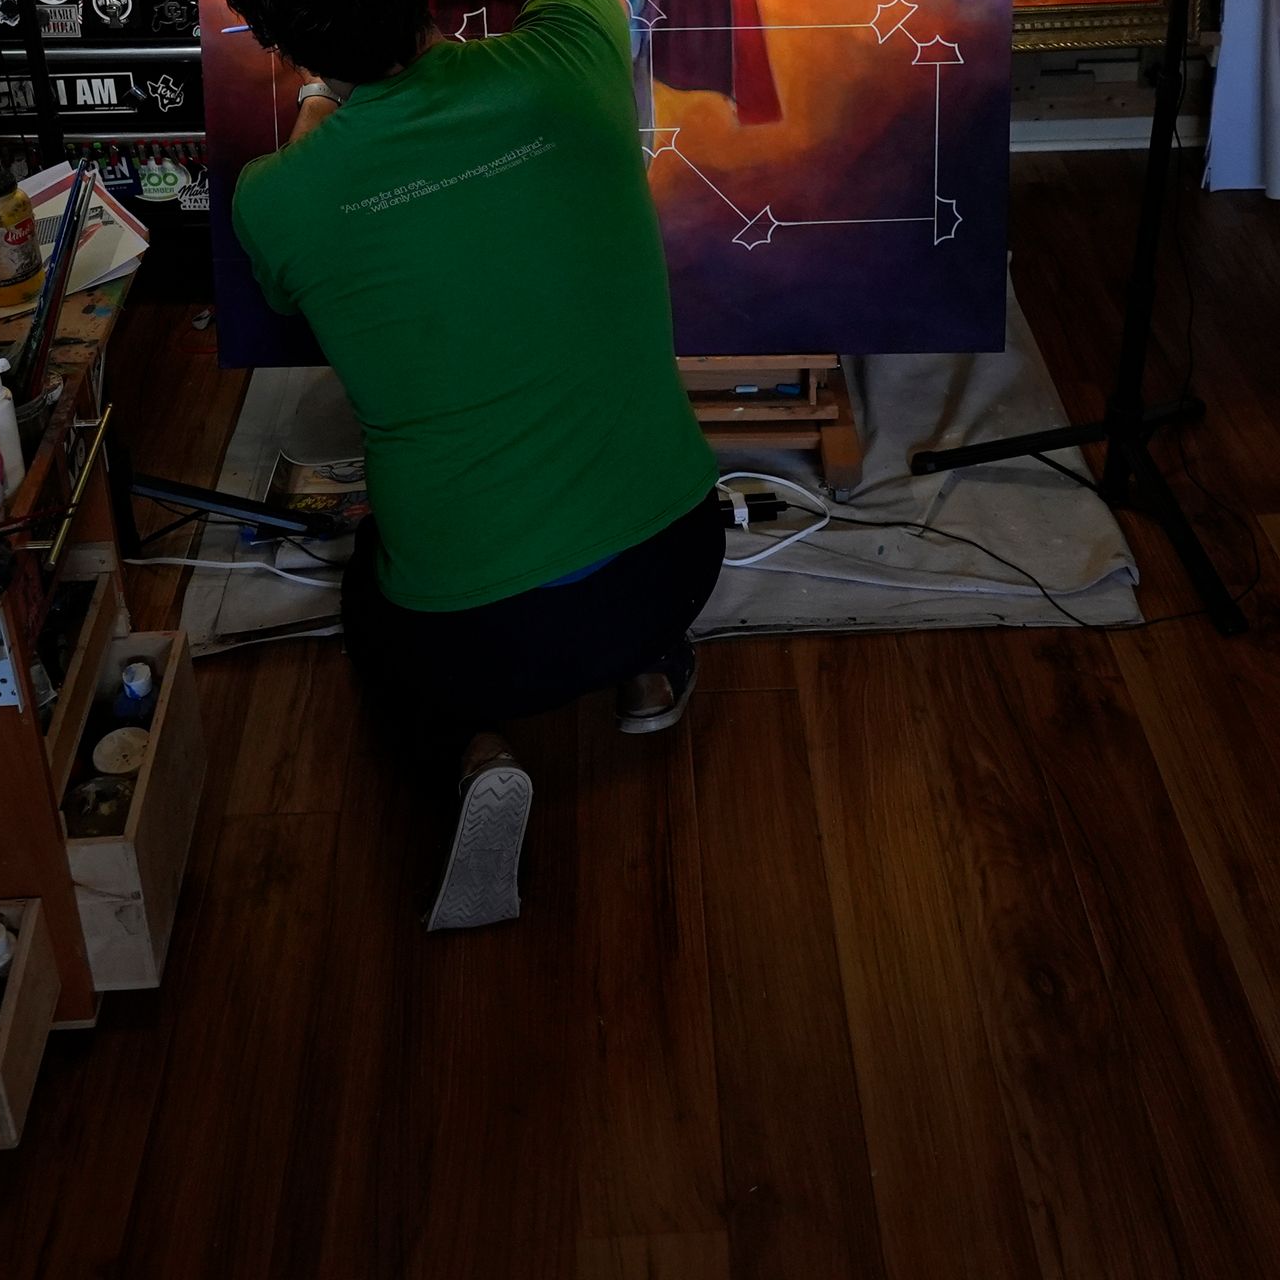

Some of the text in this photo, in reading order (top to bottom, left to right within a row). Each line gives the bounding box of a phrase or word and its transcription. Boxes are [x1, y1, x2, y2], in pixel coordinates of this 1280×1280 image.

[76, 78, 118, 106] AM
[389, 193, 411, 207] only
[411, 183, 441, 199] make
[440, 177, 459, 188] the
[458, 163, 489, 181] whole
[488, 151, 517, 169] world
